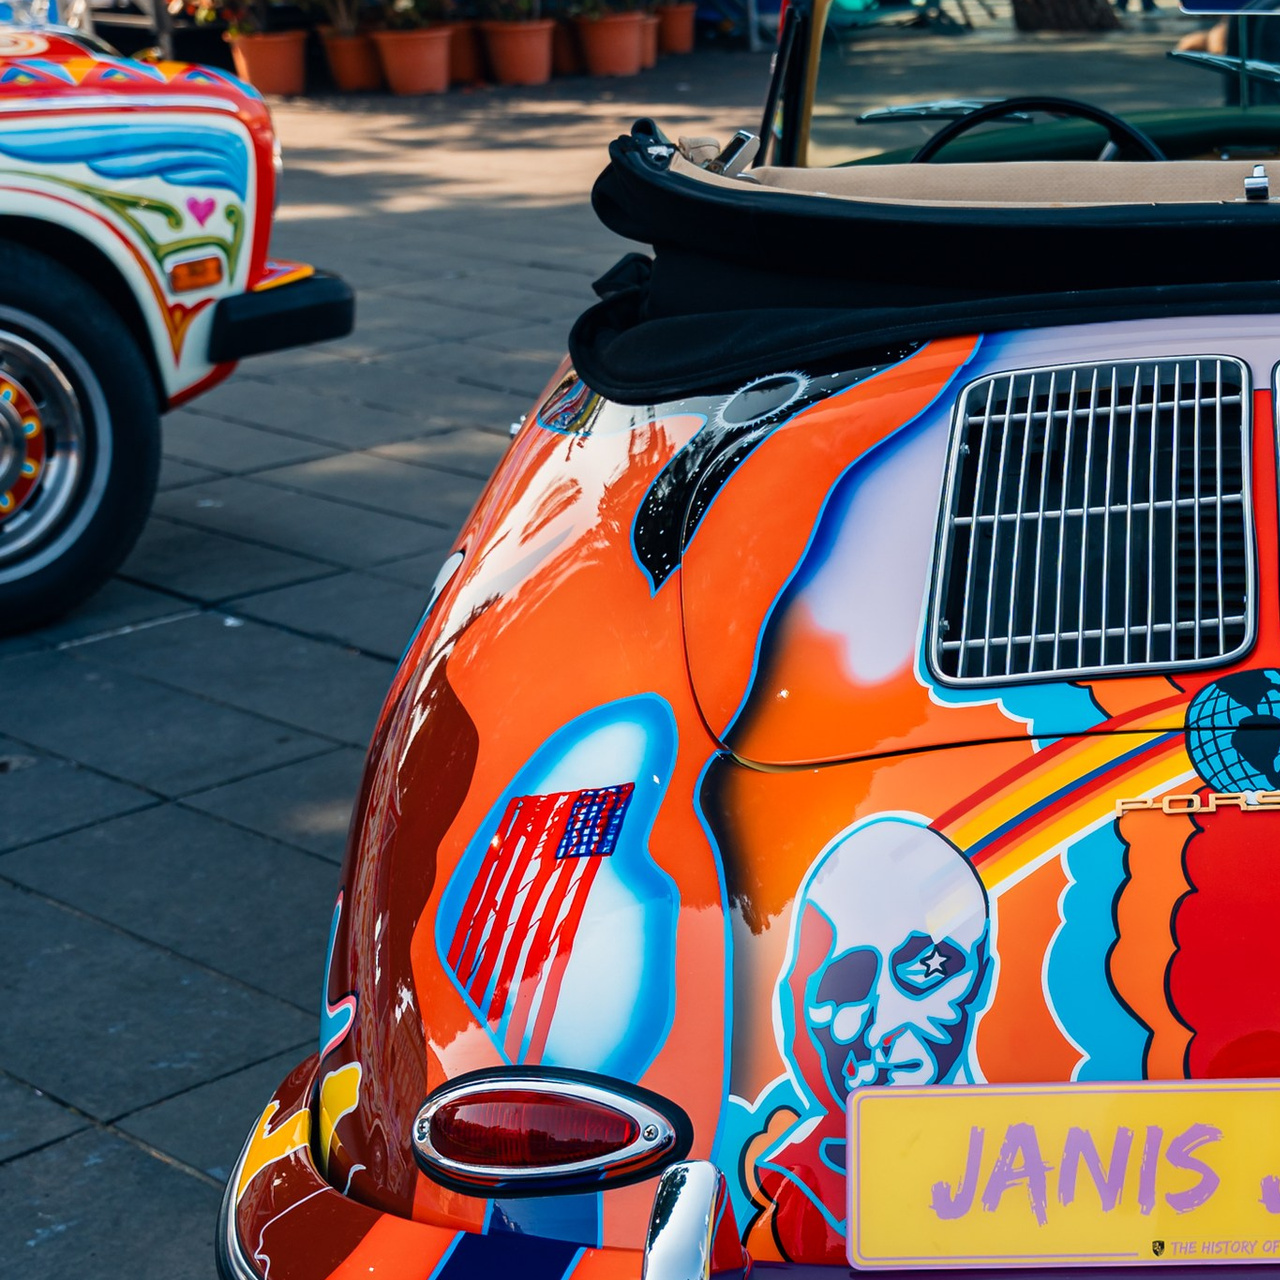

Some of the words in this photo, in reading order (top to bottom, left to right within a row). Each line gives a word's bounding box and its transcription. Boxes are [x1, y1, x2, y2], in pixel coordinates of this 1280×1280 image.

[931, 1122, 1225, 1227] JANIS
[1171, 1241, 1197, 1255] THE
[1201, 1240, 1258, 1255] HISTORY
[1262, 1239, 1280, 1254] OF
